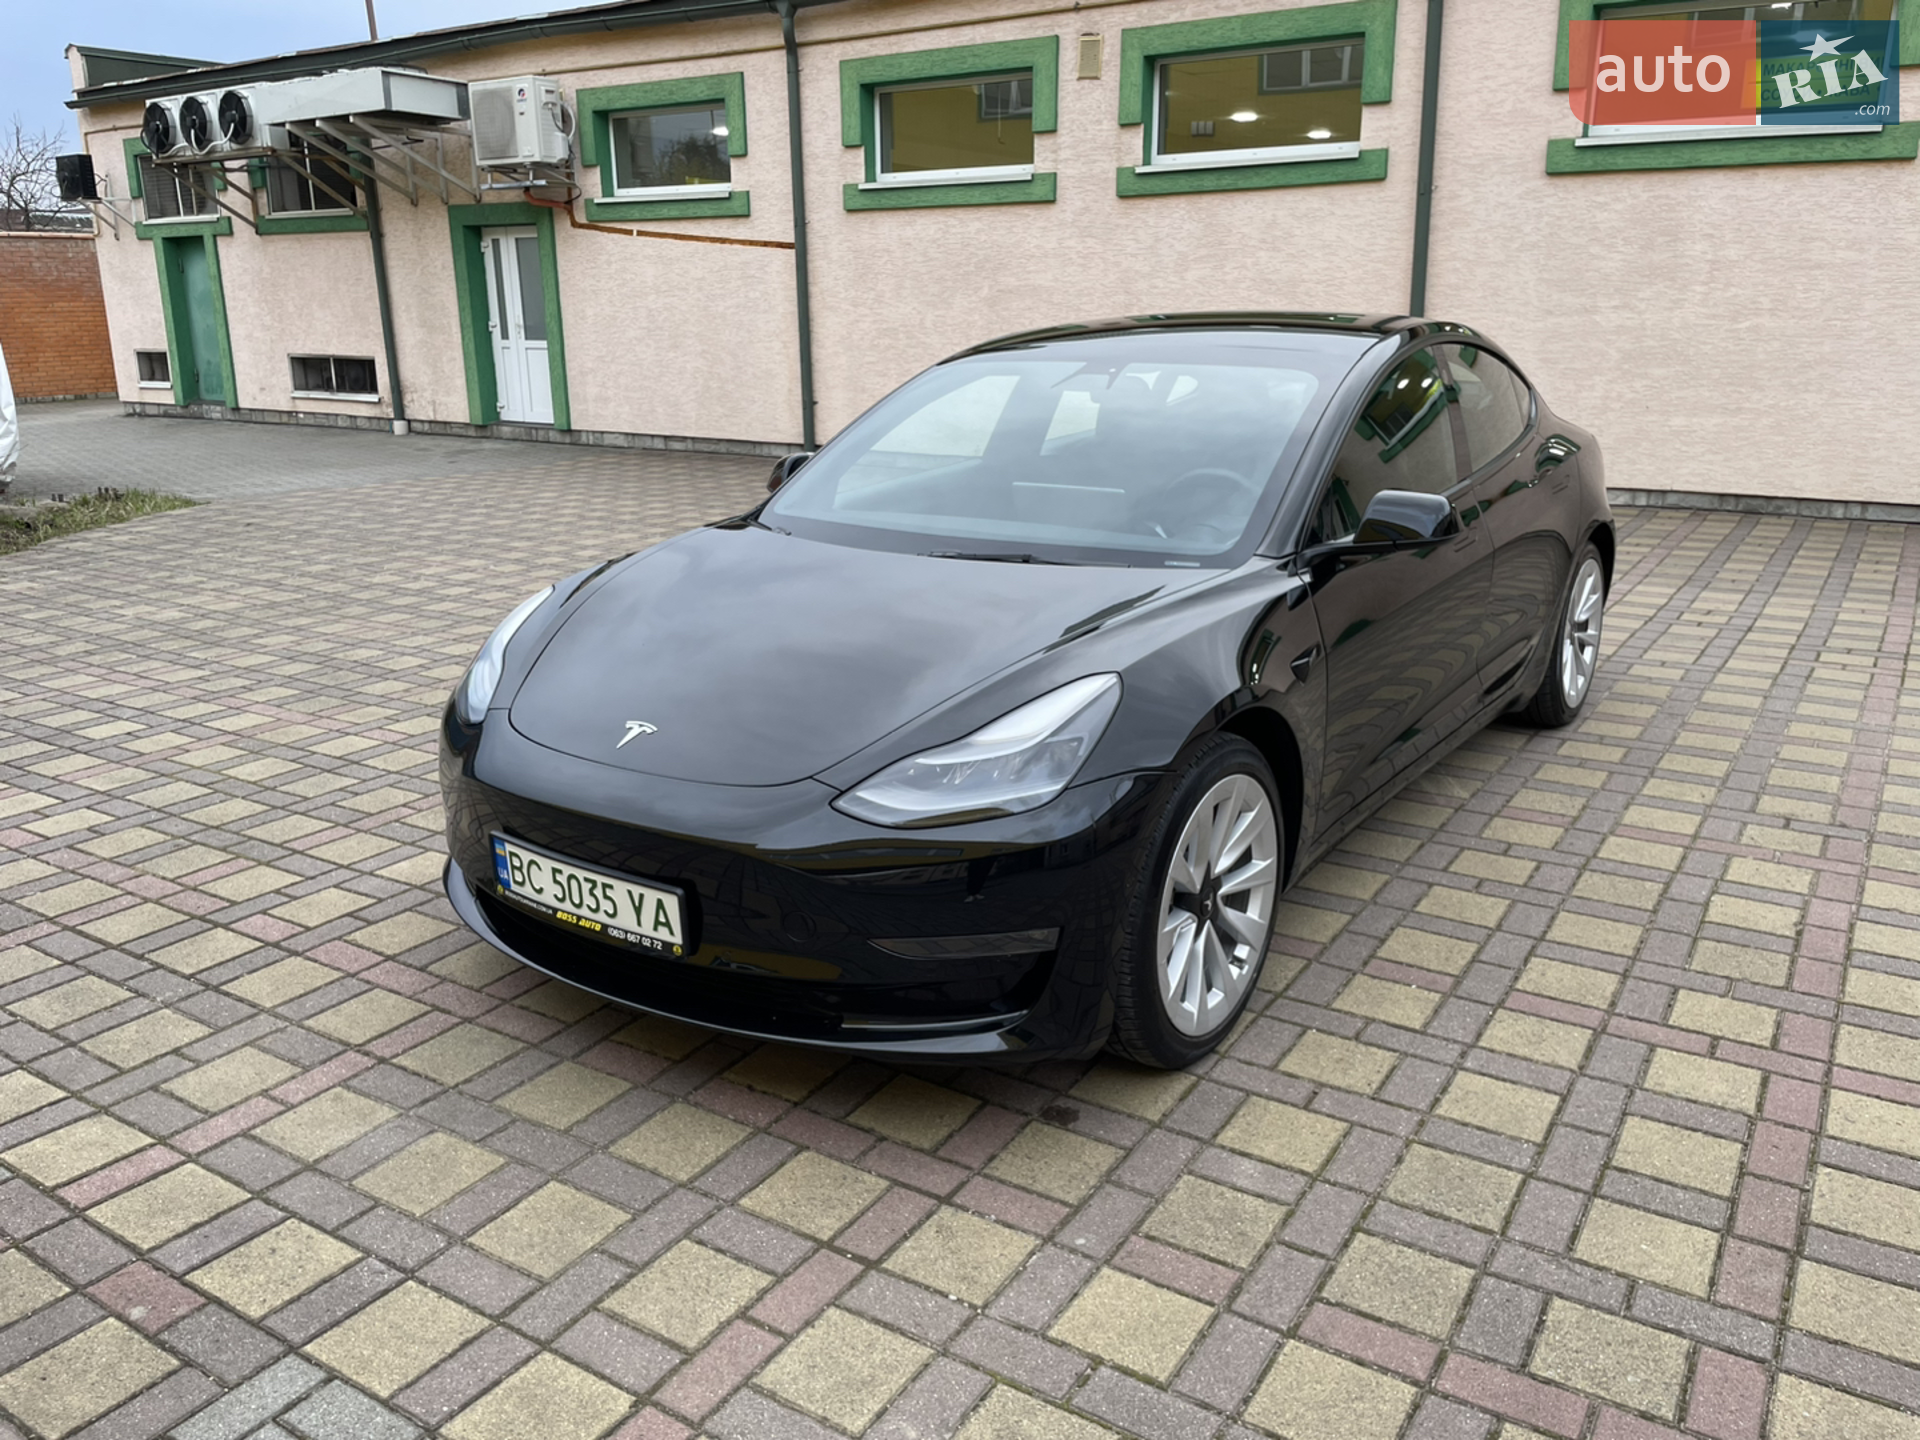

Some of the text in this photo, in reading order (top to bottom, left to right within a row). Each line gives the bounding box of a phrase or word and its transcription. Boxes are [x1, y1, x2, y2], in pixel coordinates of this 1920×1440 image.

[508, 851, 544, 896] BC
[551, 866, 618, 919] 5035
[627, 889, 676, 937] YA
[556, 910, 602, 932] BOSS AUTO
[652, 939, 663, 950] 72
